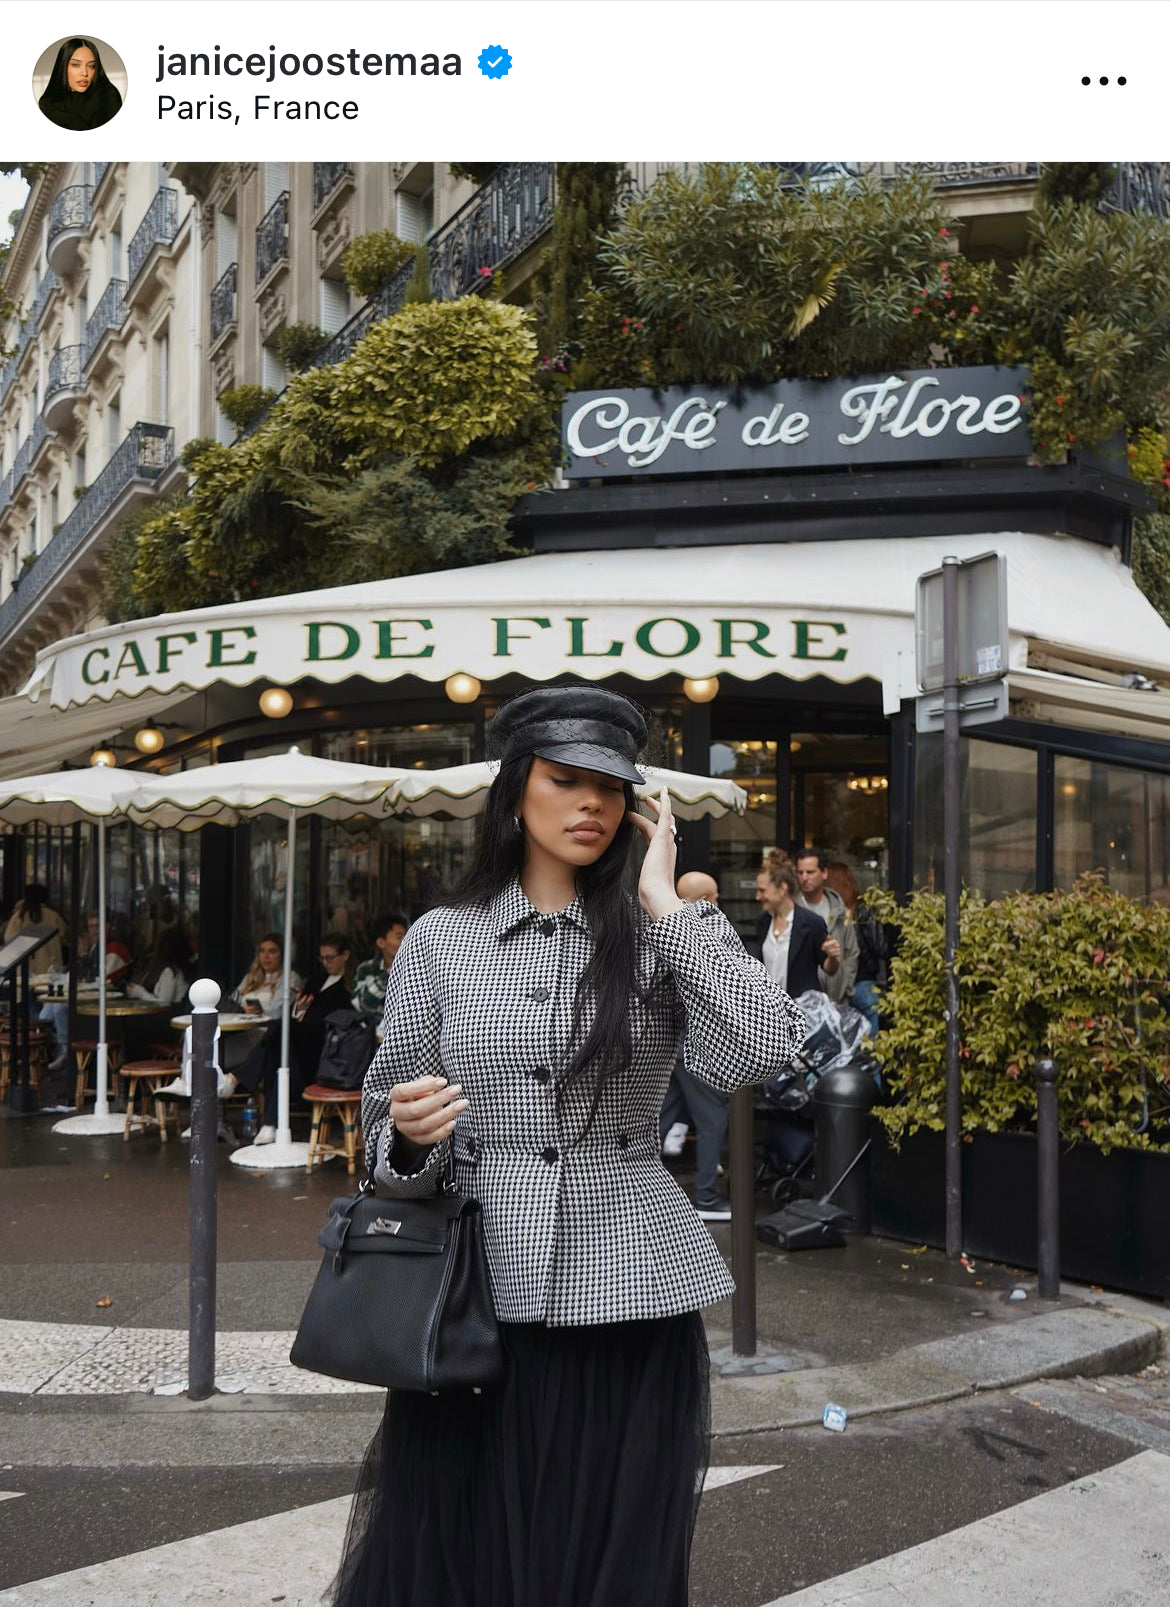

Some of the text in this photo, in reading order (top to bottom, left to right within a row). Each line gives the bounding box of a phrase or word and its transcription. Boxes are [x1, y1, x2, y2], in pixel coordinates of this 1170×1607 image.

[567, 375, 1023, 467] Café de Flore
[81, 616, 849, 686] CAFE DE FLORE
